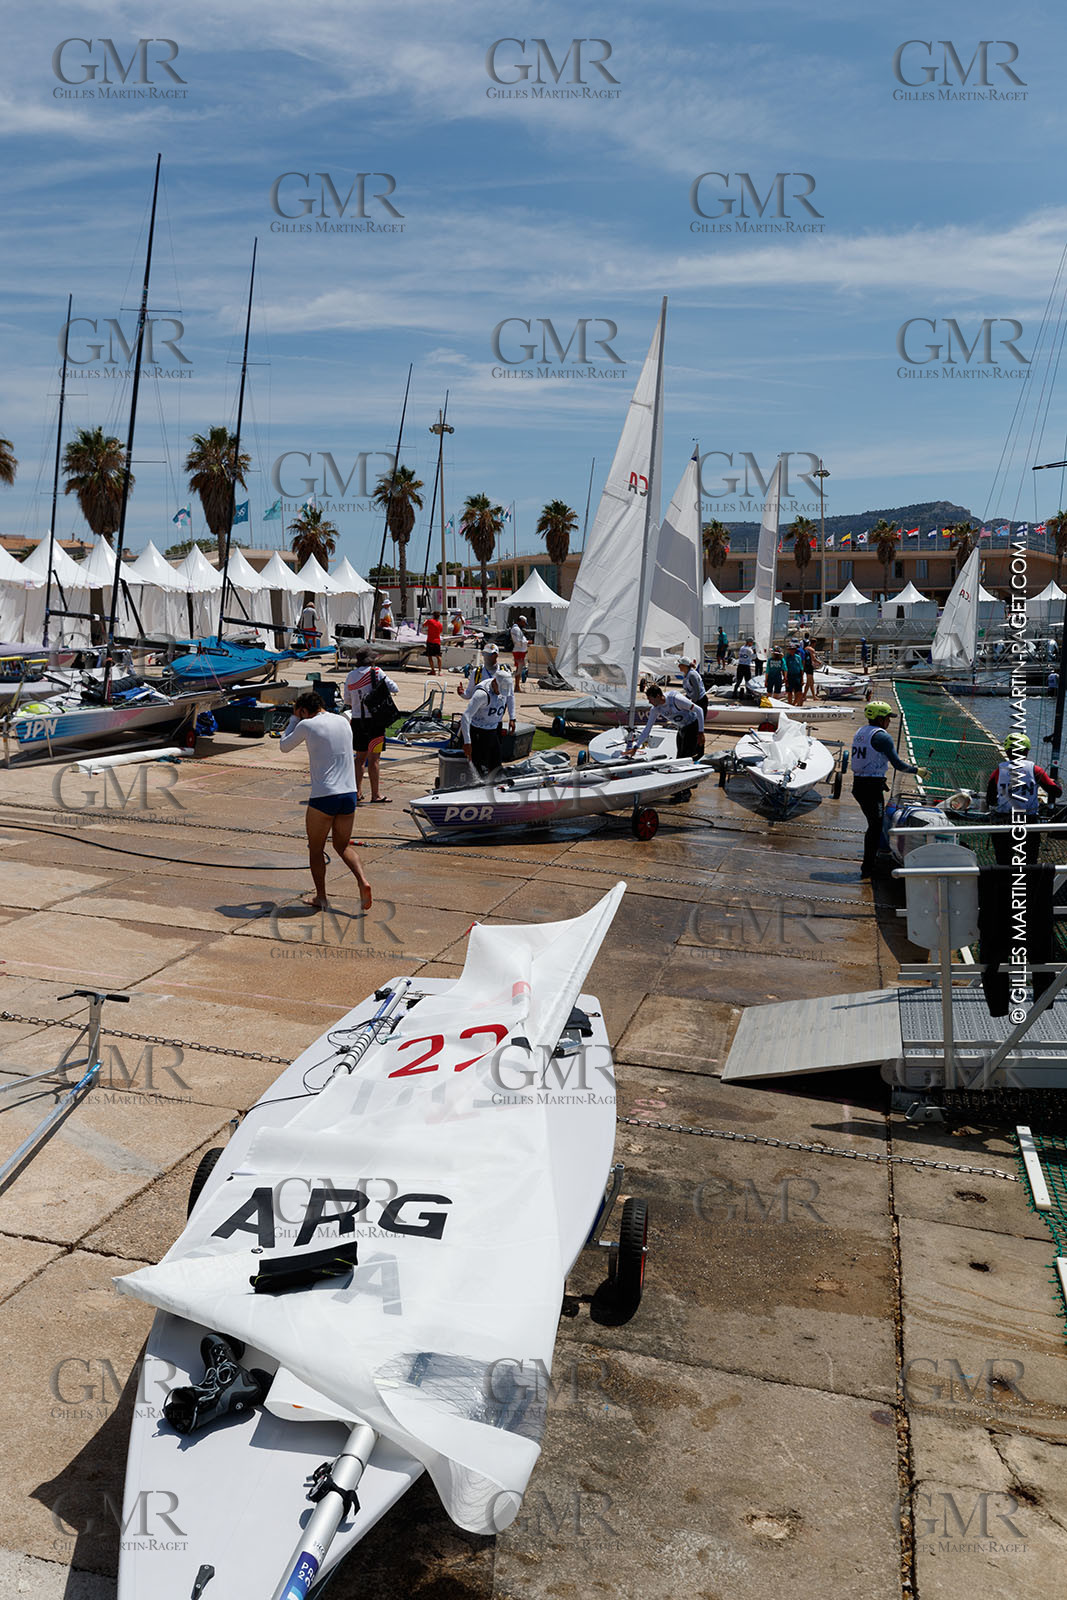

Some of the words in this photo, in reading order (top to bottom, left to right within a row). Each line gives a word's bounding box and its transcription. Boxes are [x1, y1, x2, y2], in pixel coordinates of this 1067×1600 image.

[487, 705, 505, 716] PO
[801, 711, 824, 719] PARIS
[24, 718, 58, 740] JPN
[852, 746, 867, 759] PN
[999, 782, 1035, 797] JN
[444, 806, 494, 822] POR
[211, 1187, 453, 1248] ARG
